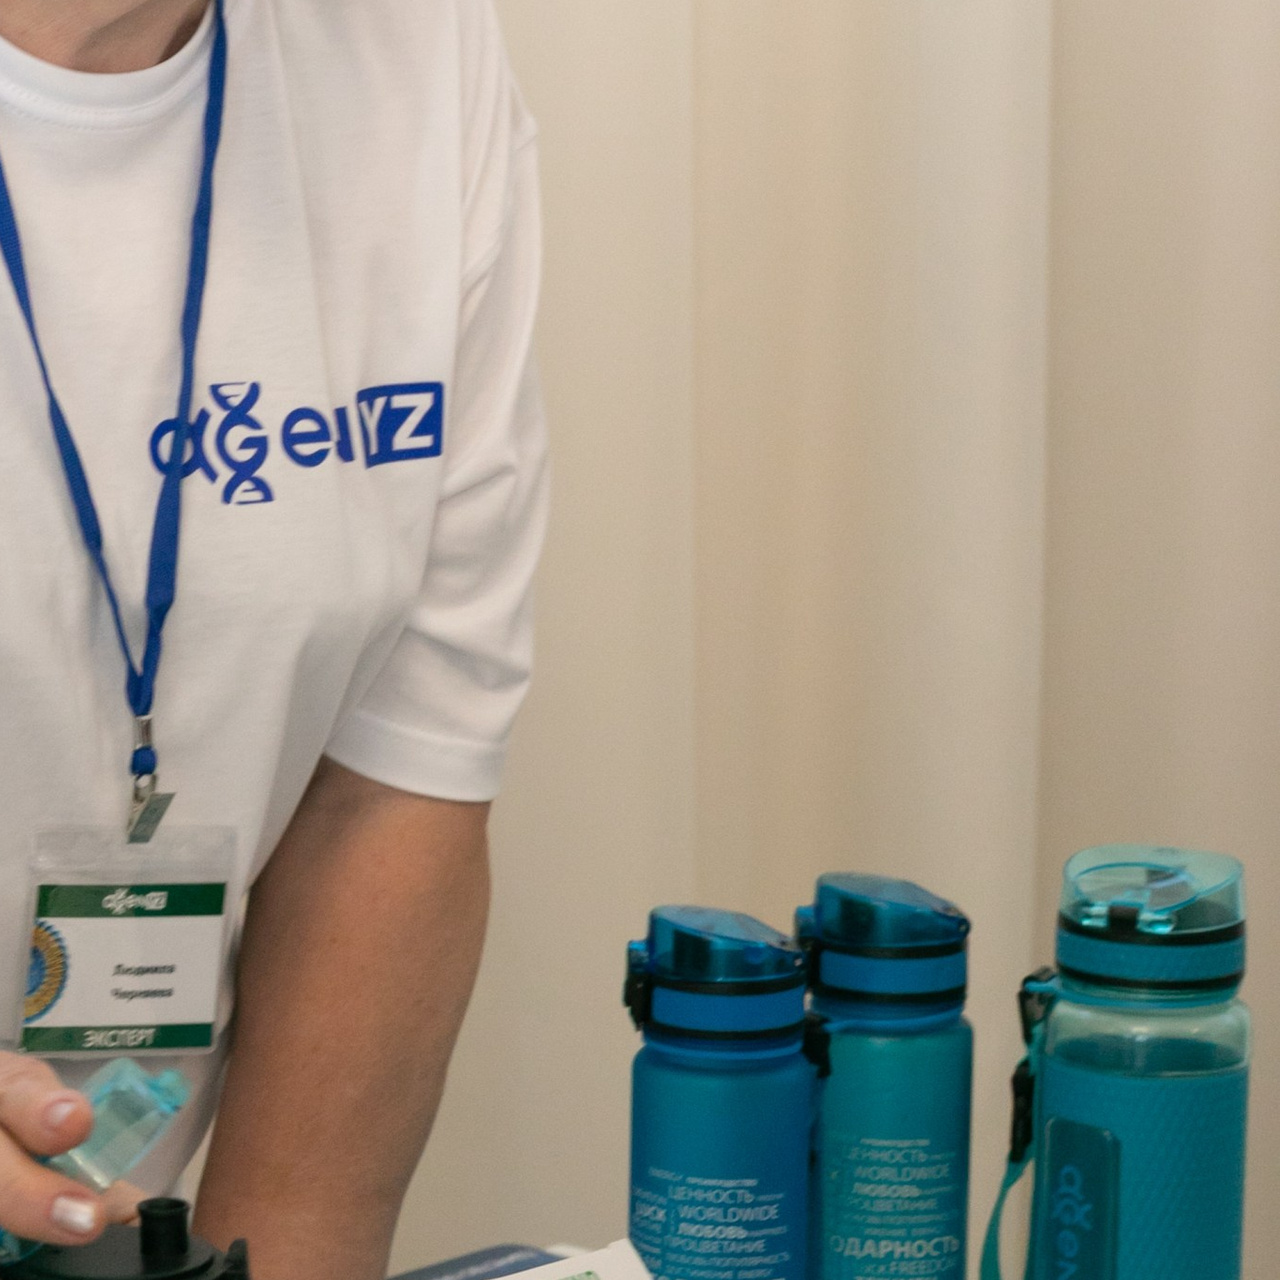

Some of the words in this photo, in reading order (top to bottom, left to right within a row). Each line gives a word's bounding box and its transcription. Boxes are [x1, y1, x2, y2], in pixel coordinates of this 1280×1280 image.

[82, 1027, 156, 1048] ЭКСПЕРТ
[677, 1203, 780, 1223] WORLDWIDE
[677, 1222, 749, 1240] ЛЮБОВЬ
